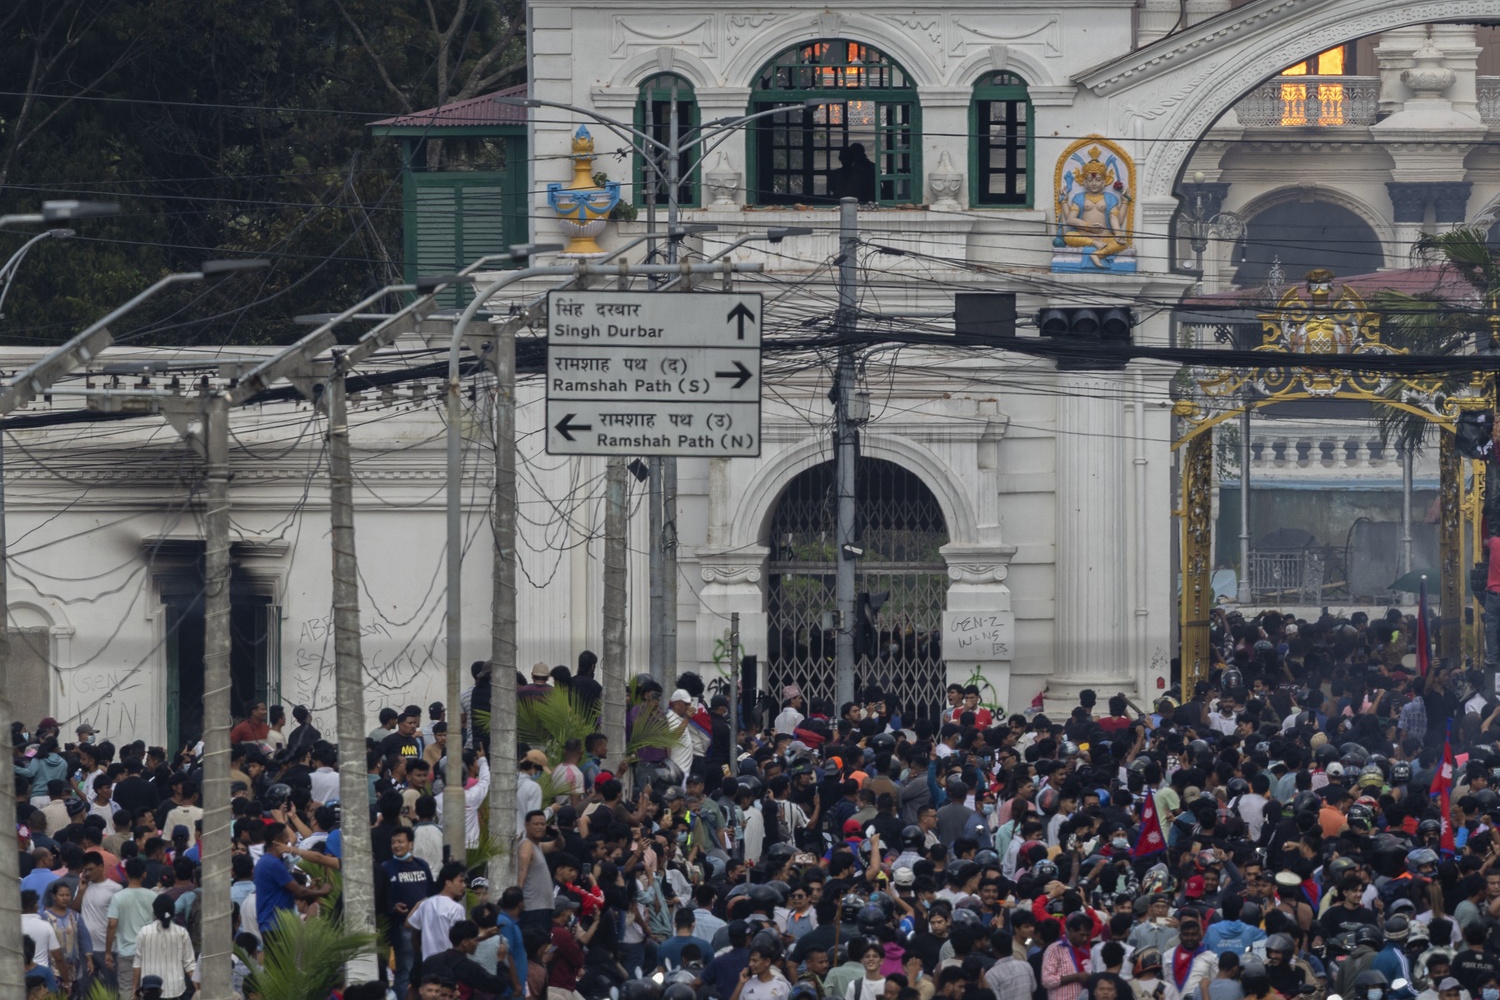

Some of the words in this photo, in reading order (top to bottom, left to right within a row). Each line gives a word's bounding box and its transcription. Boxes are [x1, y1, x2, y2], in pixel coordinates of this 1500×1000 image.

[555, 298, 585, 317] सिंह
[596, 303, 642, 317] दरबार
[554, 324, 600, 340] Singh
[607, 324, 664, 338] Durbar
[554, 357, 611, 372] रामशाह
[623, 358, 648, 372] पथ
[553, 378, 628, 392] Ramshah
[635, 379, 671, 393] Path
[599, 413, 657, 428] रामशाह
[668, 413, 693, 428] पथ
[597, 433, 671, 448] Ramshah
[678, 434, 714, 448] Path
